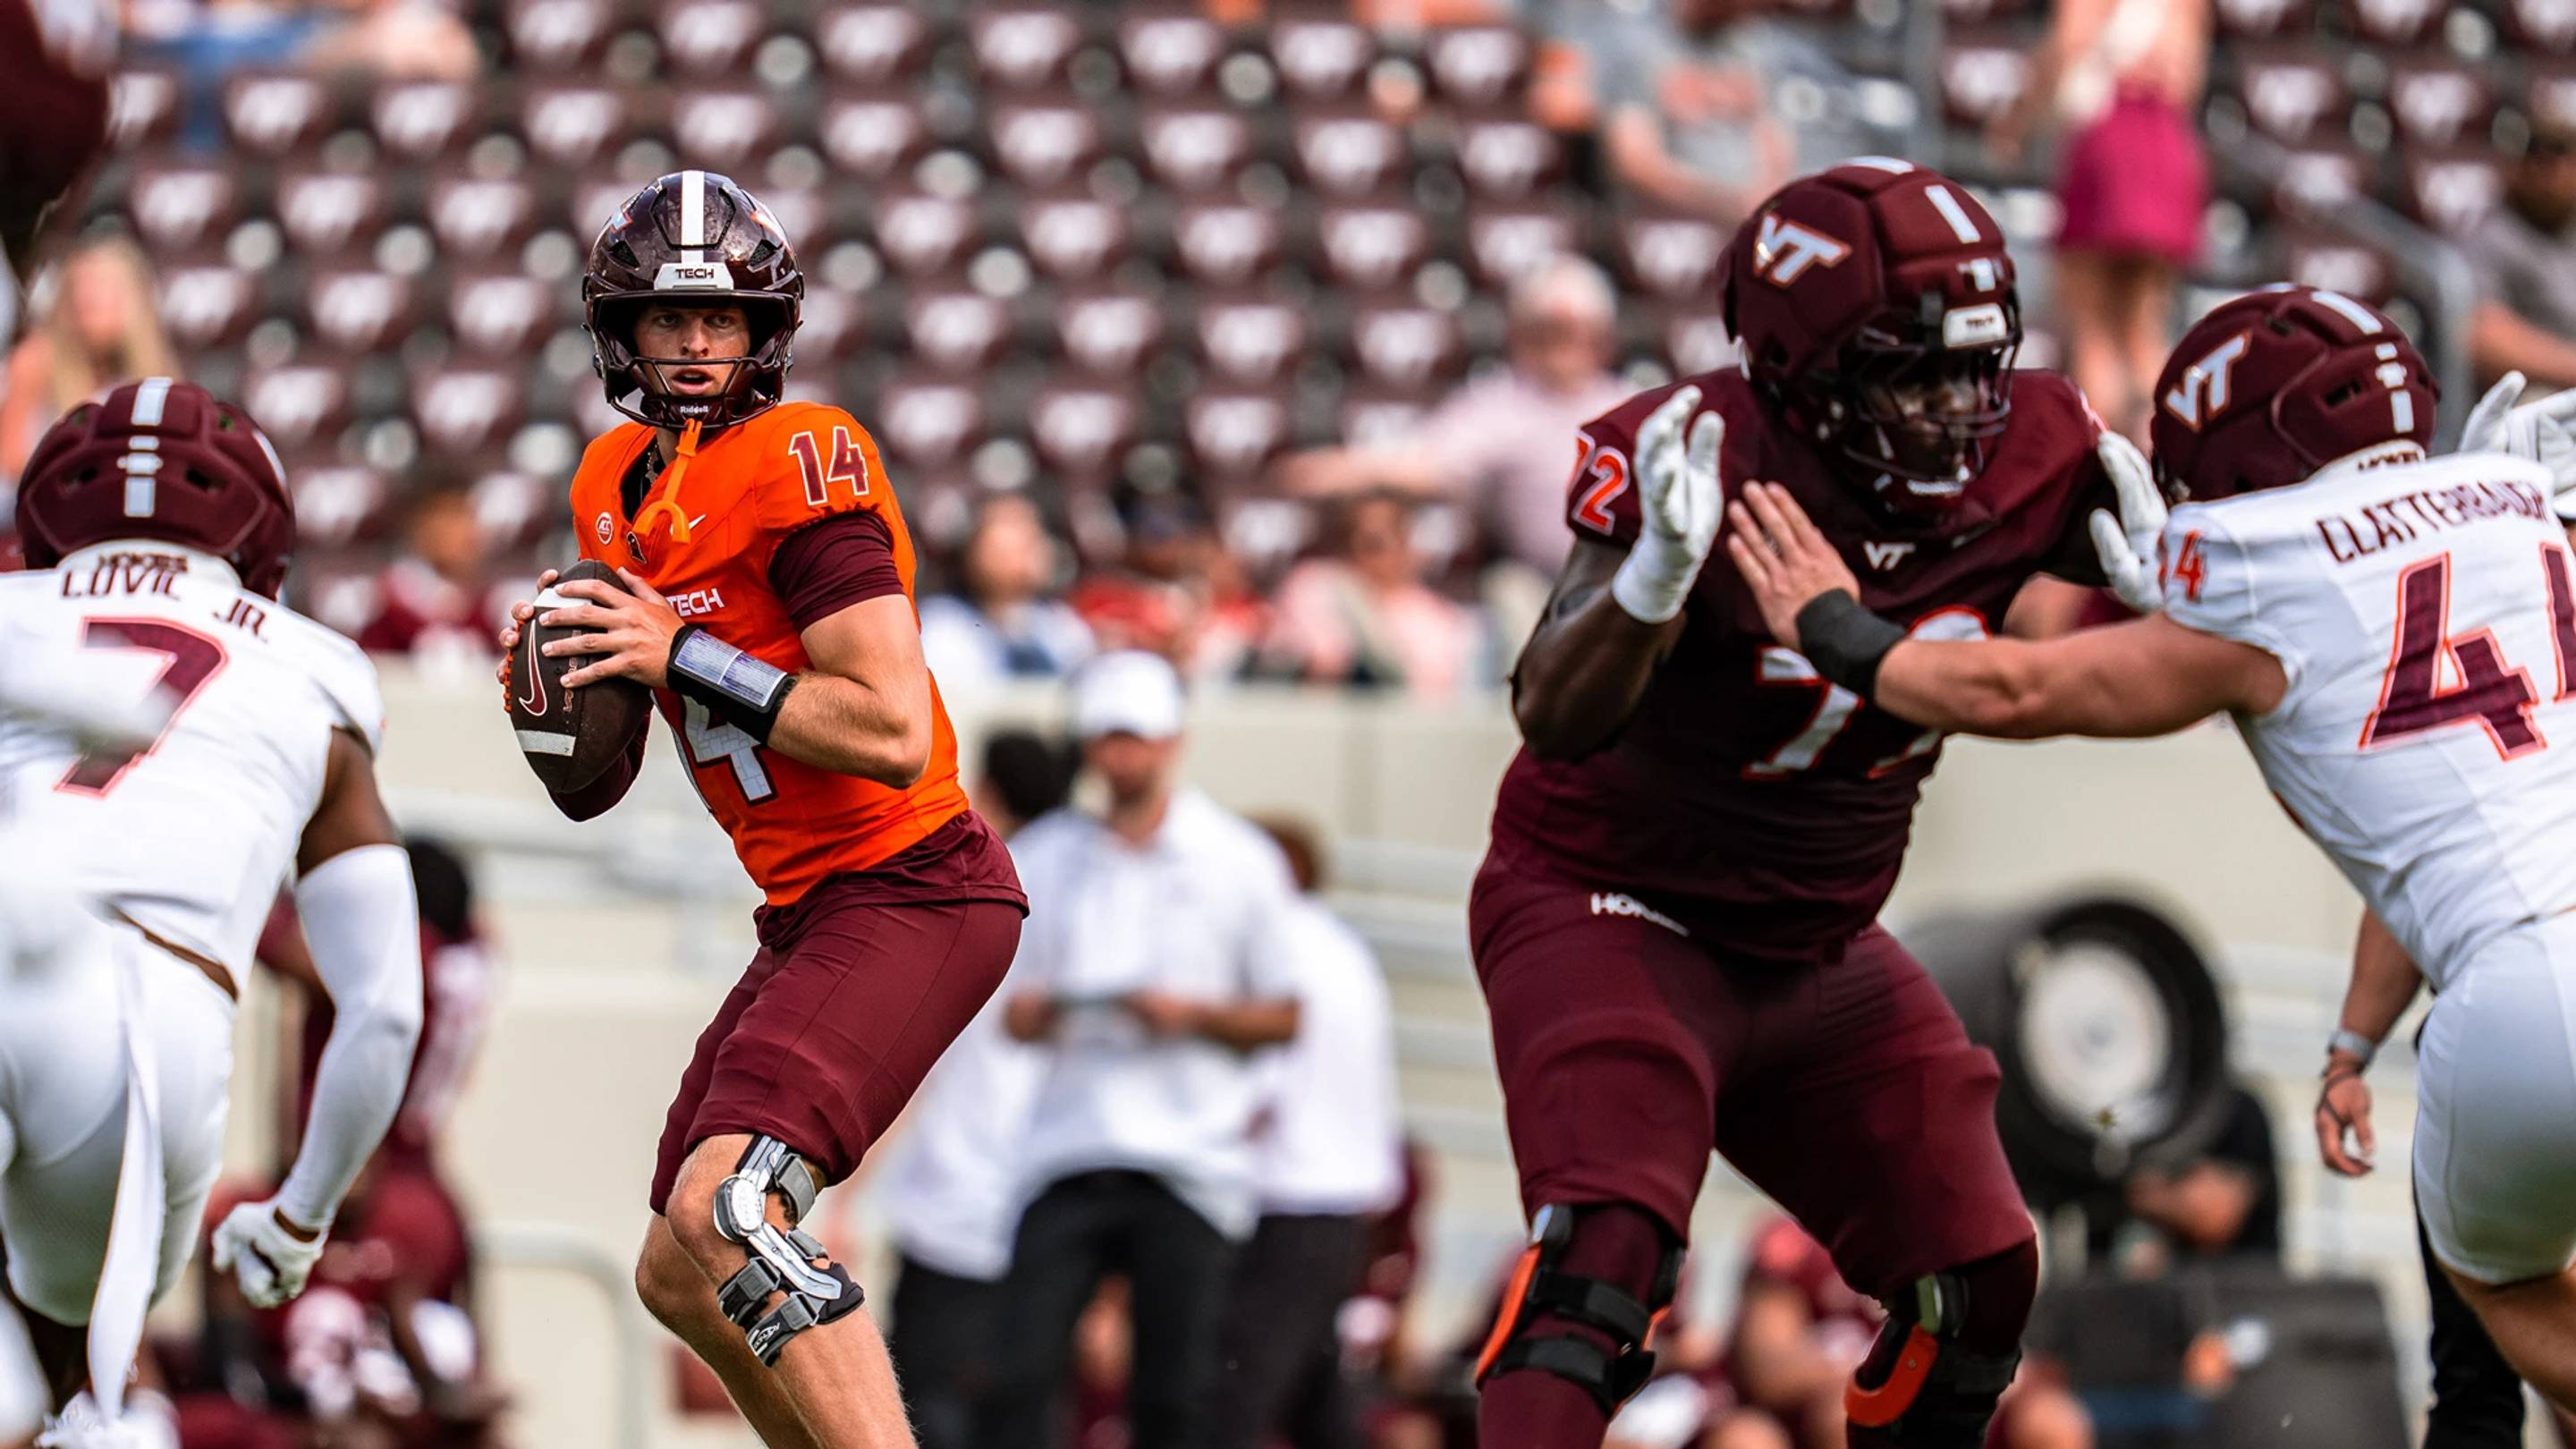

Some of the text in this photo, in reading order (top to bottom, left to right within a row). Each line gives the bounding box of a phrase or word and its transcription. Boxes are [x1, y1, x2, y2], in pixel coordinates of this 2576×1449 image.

[675, 268, 714, 279] TECH
[1753, 214, 1852, 288] VT
[2165, 329, 2252, 433] VT
[680, 405, 708, 413] Riddell
[788, 426, 869, 506] 14
[1865, 540, 1915, 570] VT
[665, 588, 725, 617] TECH
[54, 615, 229, 800] 7
